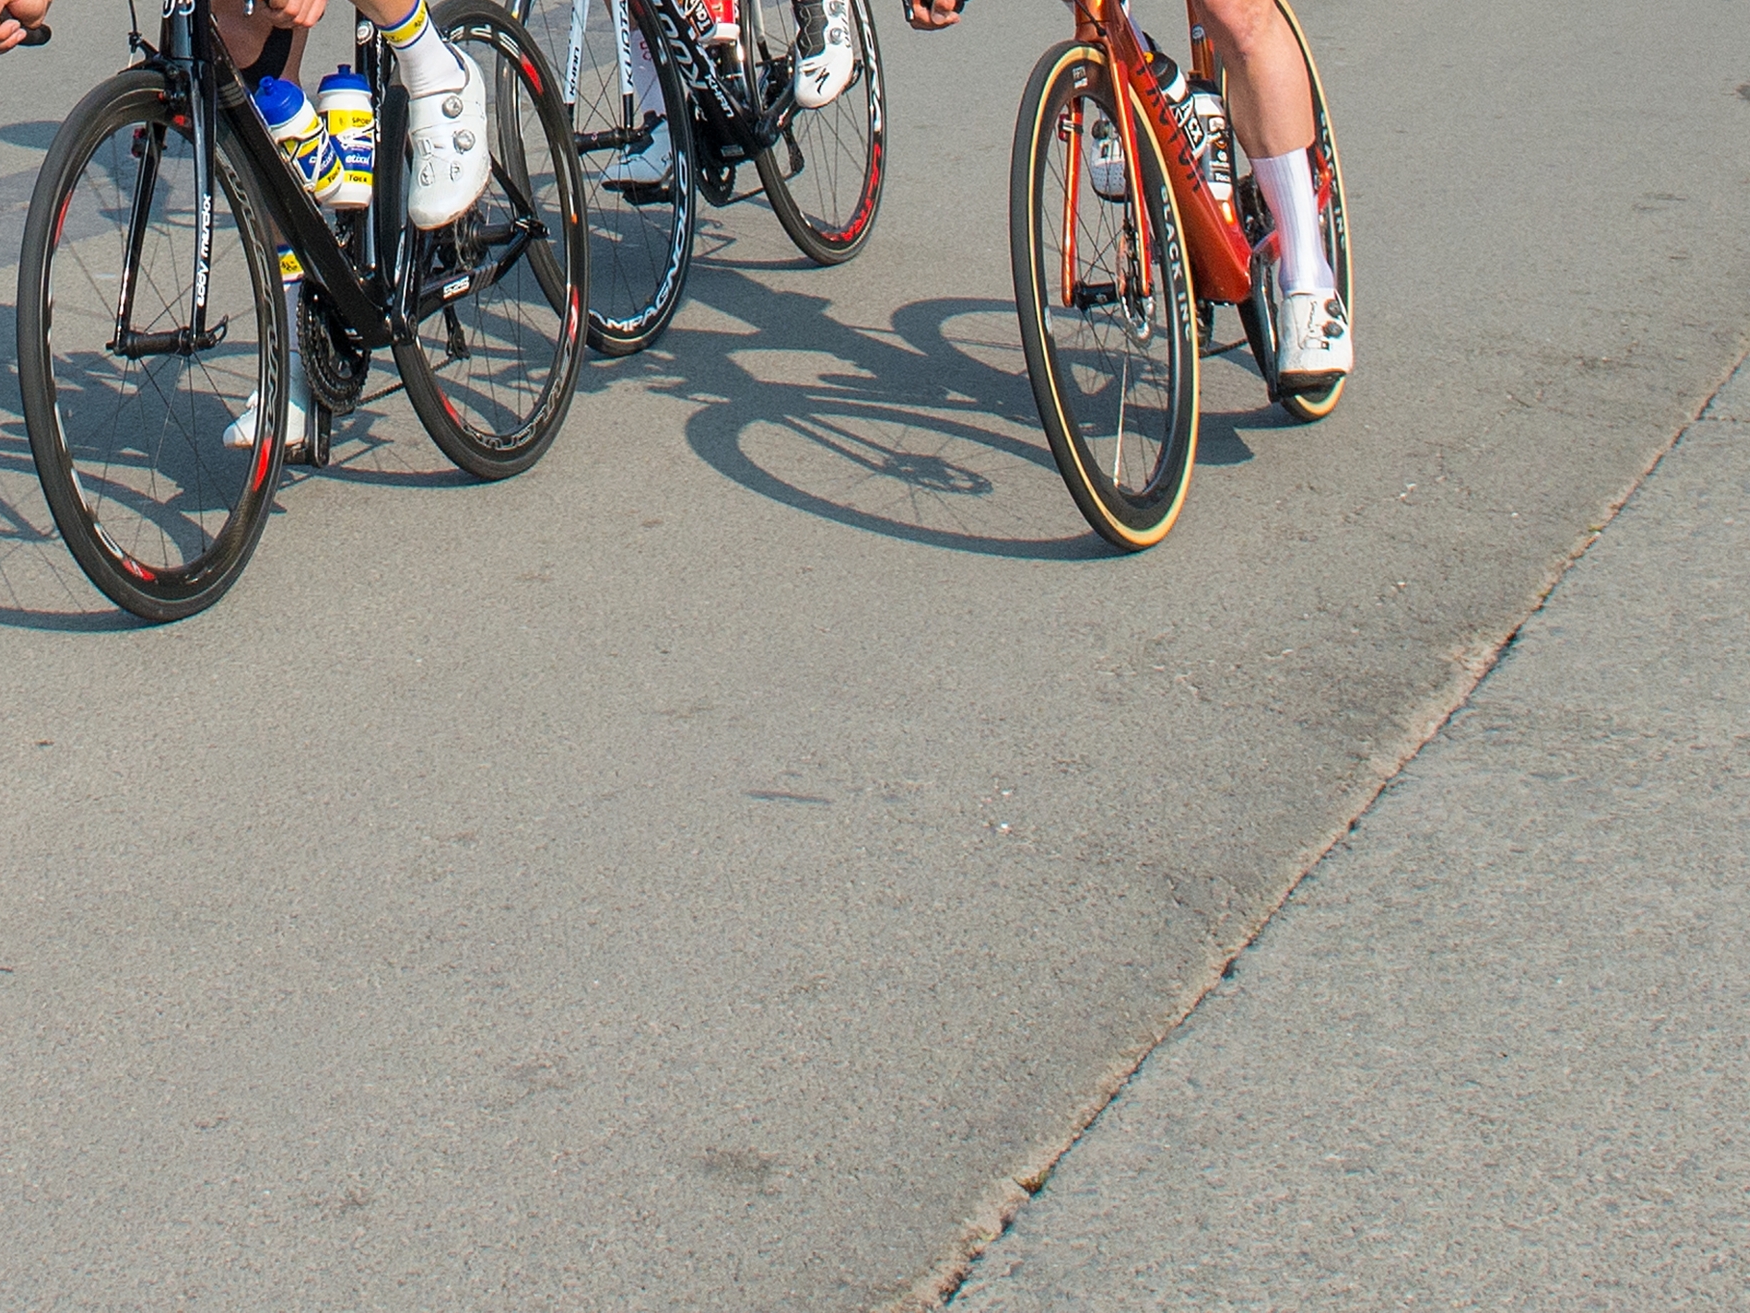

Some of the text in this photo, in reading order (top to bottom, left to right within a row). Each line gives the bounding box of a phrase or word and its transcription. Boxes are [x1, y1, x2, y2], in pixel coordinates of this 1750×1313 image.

[196, 261, 211, 308] eddy
[588, 150, 689, 333] AMPAGNOLO
[1160, 185, 1192, 342] BLACK INC
